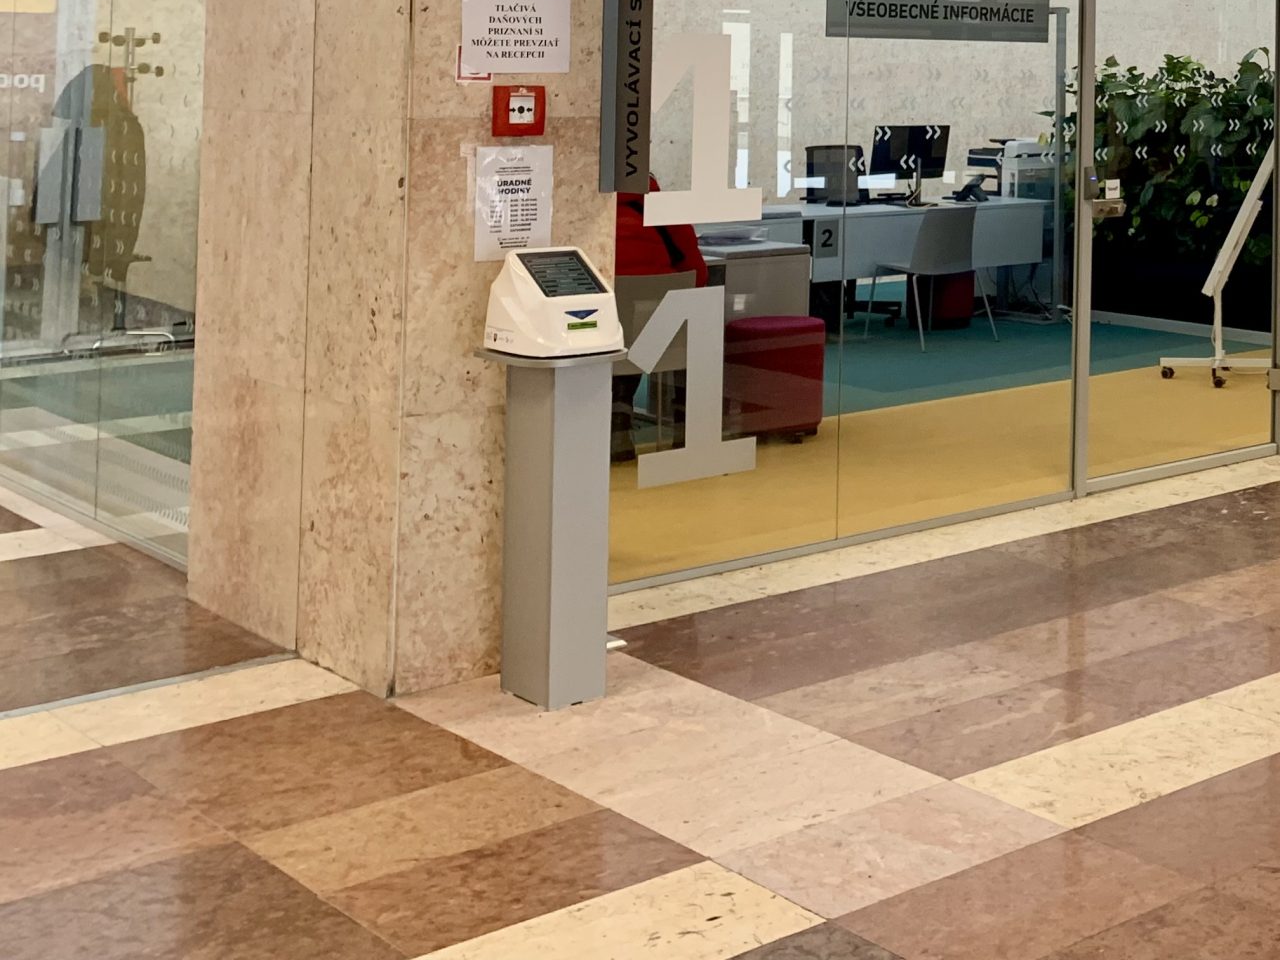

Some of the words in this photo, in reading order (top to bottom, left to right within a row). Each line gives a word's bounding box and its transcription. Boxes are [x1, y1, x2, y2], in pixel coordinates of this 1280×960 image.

[495, 3, 536, 12] TLAČIVÁ
[942, 3, 1035, 23] INFORMÁCIE
[489, 14, 542, 24] DAŇOVÝCH
[488, 26, 532, 35] PRIZNANÍ
[471, 36, 512, 47] MÔŽETE
[514, 37, 560, 47] PREVZIAŤ
[486, 50, 499, 58] NA
[501, 50, 545, 58] RECEPCII
[624, 19, 642, 177] VYVOLÁVACÍ
[643, 33, 763, 227] 1
[821, 228, 833, 248] 2
[628, 286, 757, 488] 1
